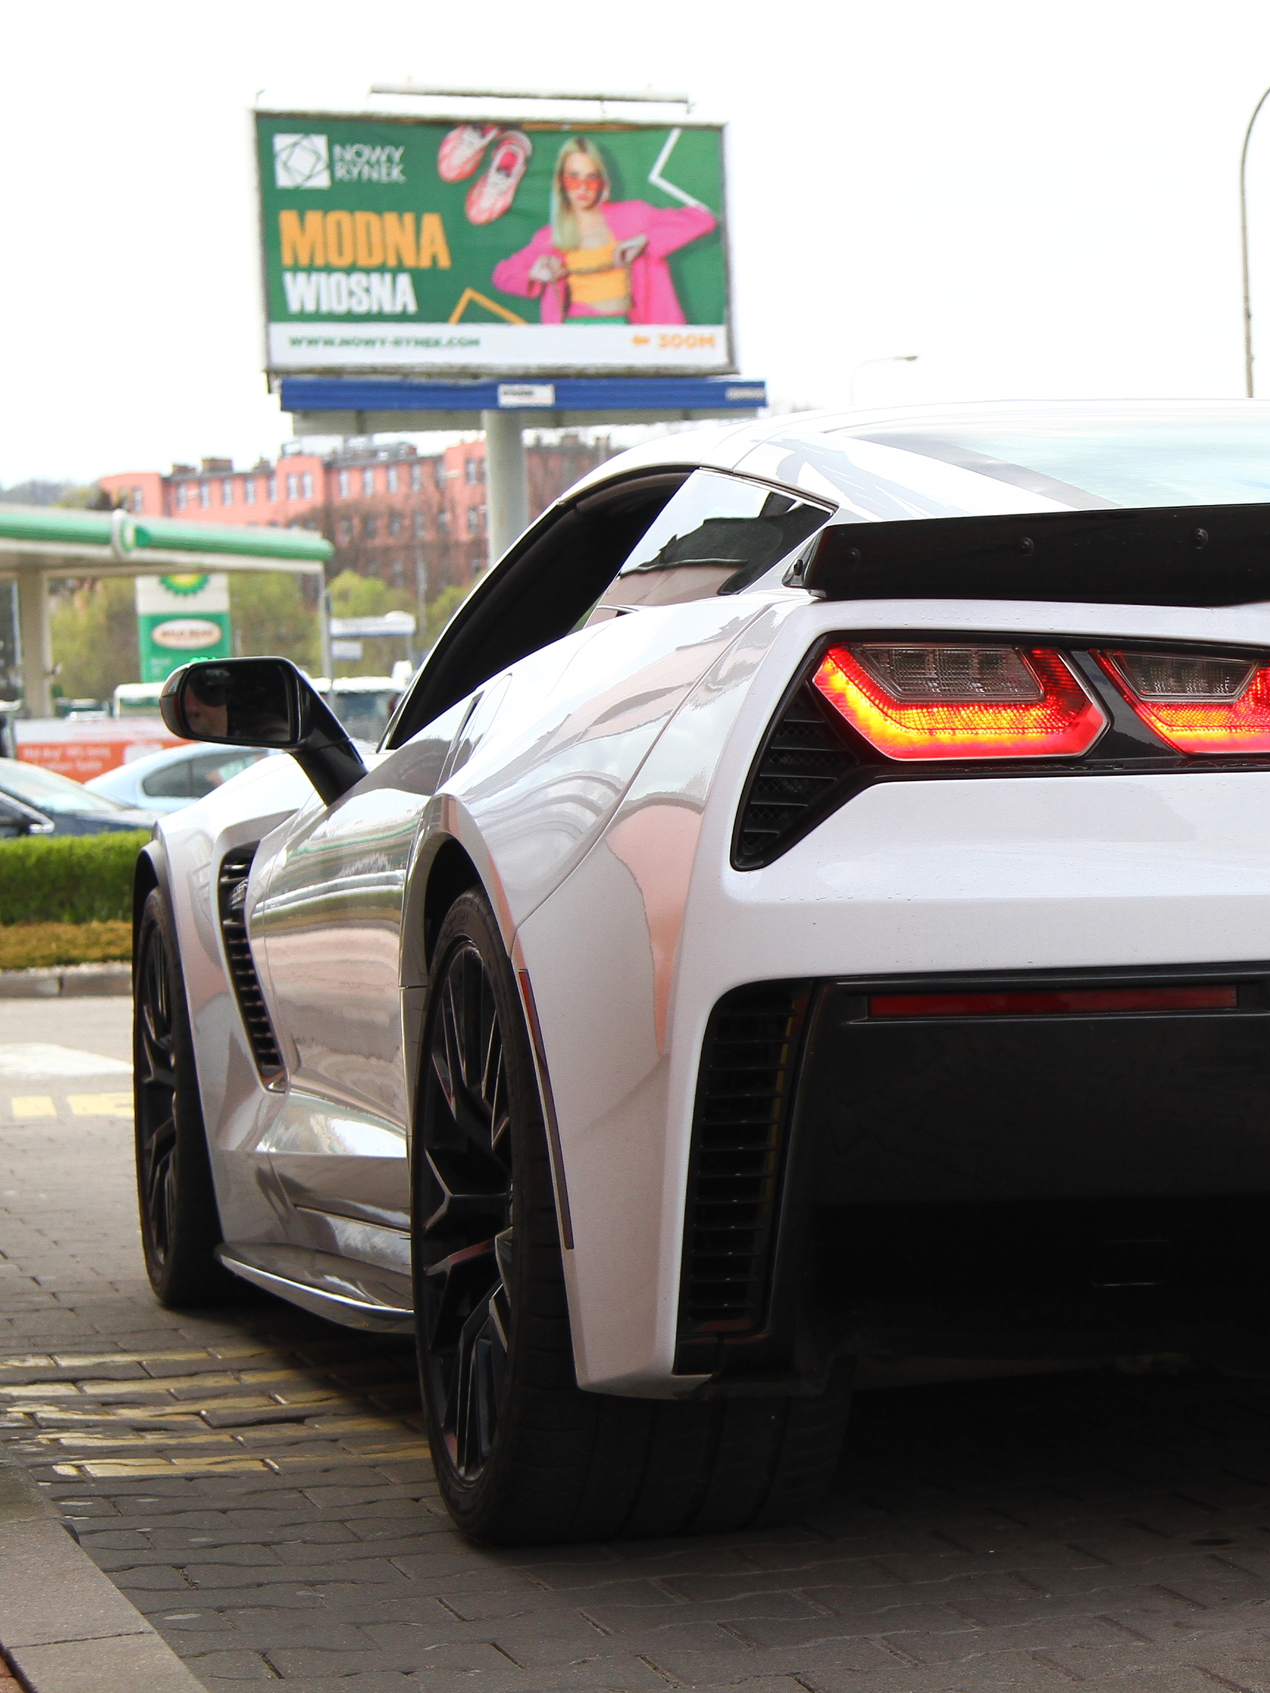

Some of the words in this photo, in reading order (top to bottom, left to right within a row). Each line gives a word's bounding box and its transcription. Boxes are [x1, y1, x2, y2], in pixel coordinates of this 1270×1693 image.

[333, 143, 406, 163] NOWY
[334, 163, 407, 184] RYNEK
[279, 209, 452, 269] MODNA
[283, 271, 418, 314] WIOSNA
